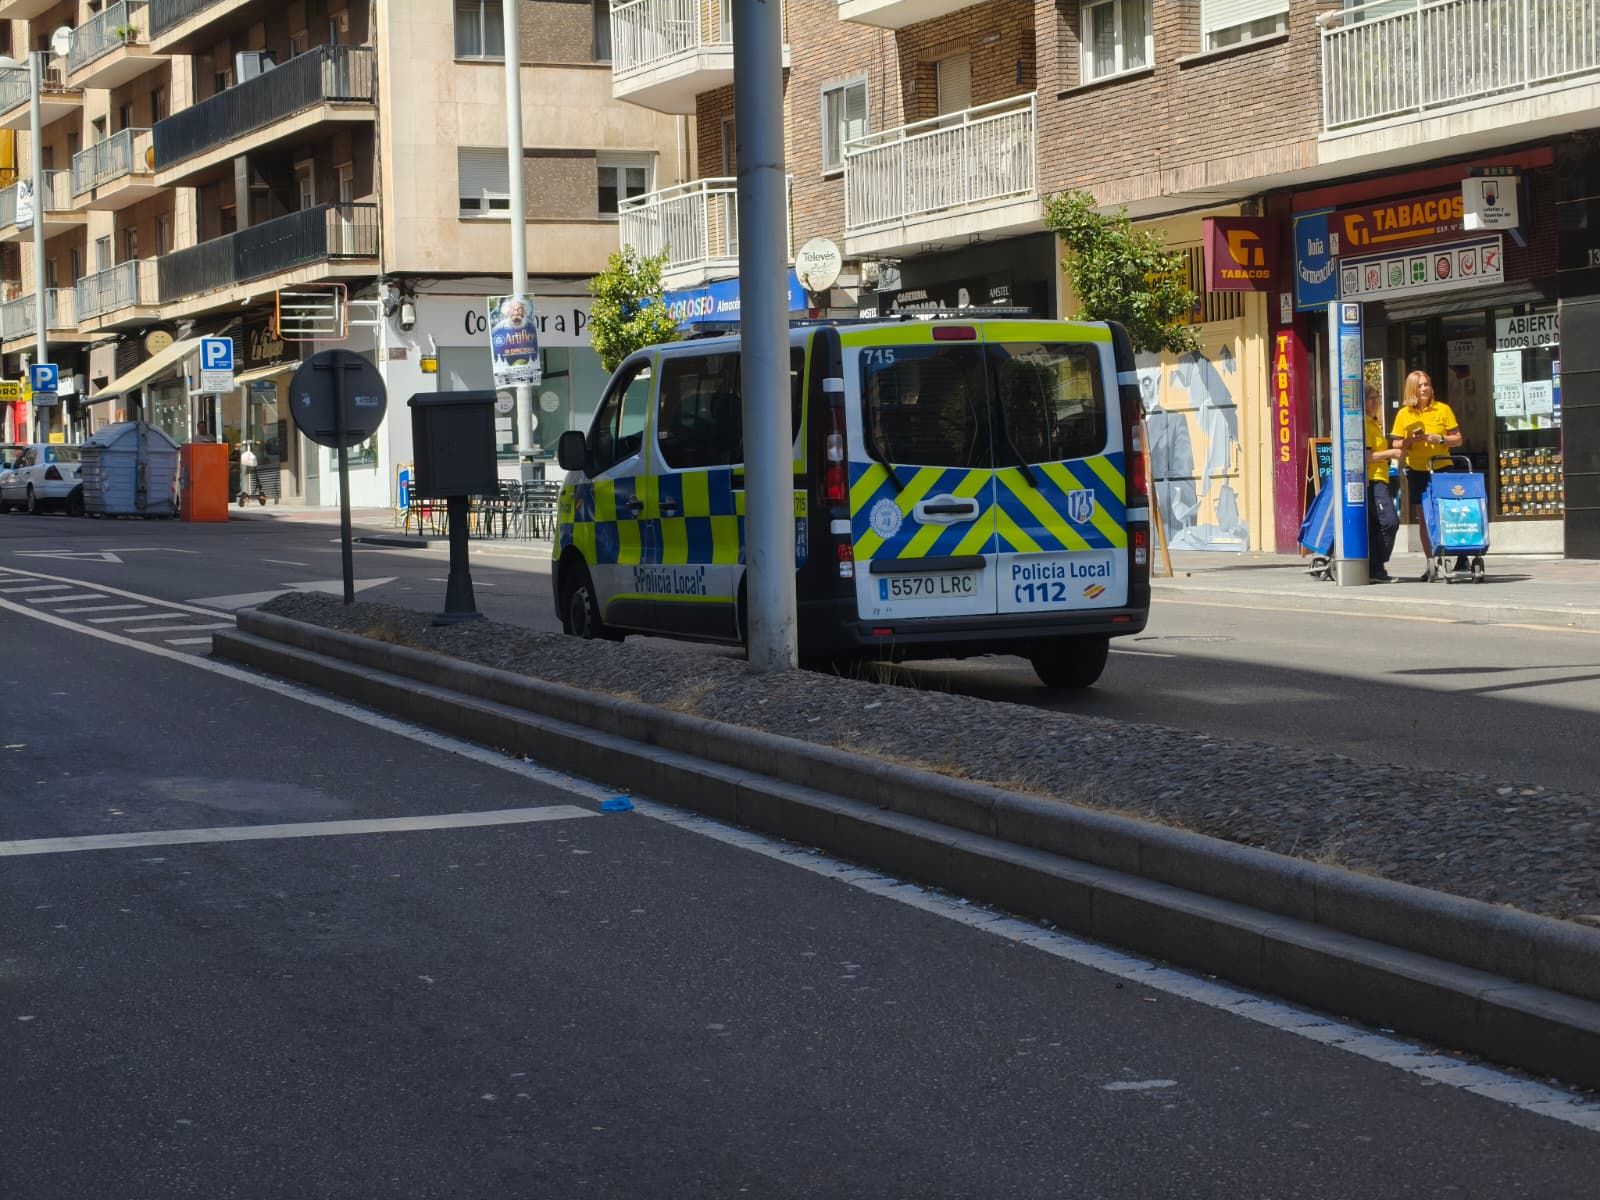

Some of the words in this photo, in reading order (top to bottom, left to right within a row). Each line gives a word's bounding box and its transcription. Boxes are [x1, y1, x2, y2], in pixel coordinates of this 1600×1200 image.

[1373, 196, 1464, 231] TABACOS
[802, 251, 836, 262] Televés
[1307, 239, 1324, 257] Doña
[1221, 269, 1270, 279] TABACOS
[1299, 256, 1336, 285] Carmencita
[989, 286, 1009, 298] AMSTEL
[859, 307, 877, 319] AMSTEL
[1498, 335, 1529, 349] TODOS
[1532, 333, 1551, 346] LOS
[207, 341, 227, 367] P
[863, 349, 895, 364] 715
[36, 367, 53, 389] P
[1277, 335, 1290, 462] TABACOS
[1012, 562, 1065, 580] Policía
[1070, 561, 1111, 578] Local
[640, 568, 672, 594] Policía
[674, 569, 701, 595] Local
[891, 577, 935, 596] 5570
[940, 575, 972, 594] LRC
[1022, 582, 1067, 603] 112
